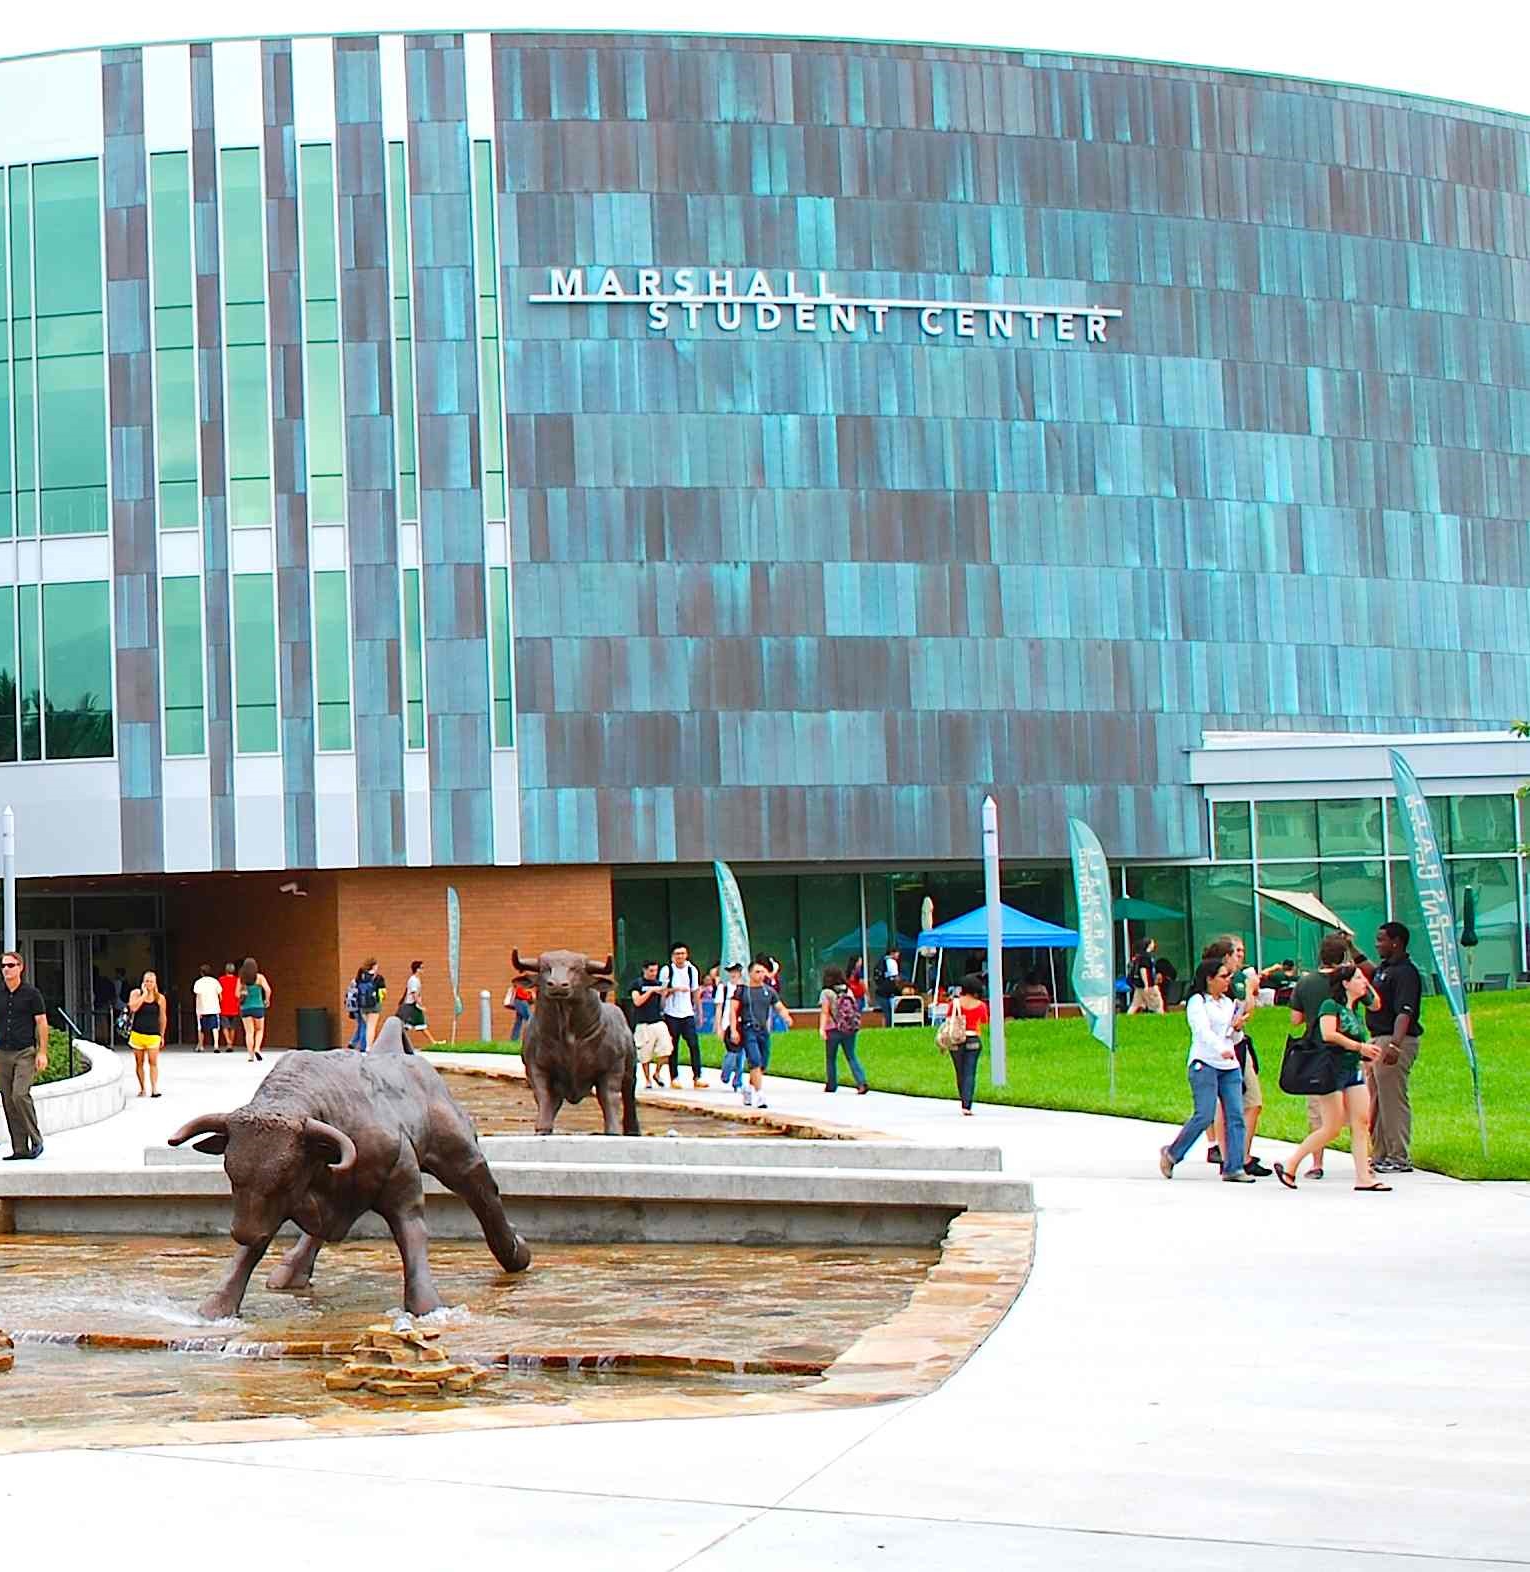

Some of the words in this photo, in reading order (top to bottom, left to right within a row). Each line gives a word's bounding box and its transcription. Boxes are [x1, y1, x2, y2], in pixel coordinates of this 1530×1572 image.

[549, 269, 836, 299] MARSHALL
[648, 301, 889, 333] STUDENT
[921, 307, 1107, 342] CENTER
